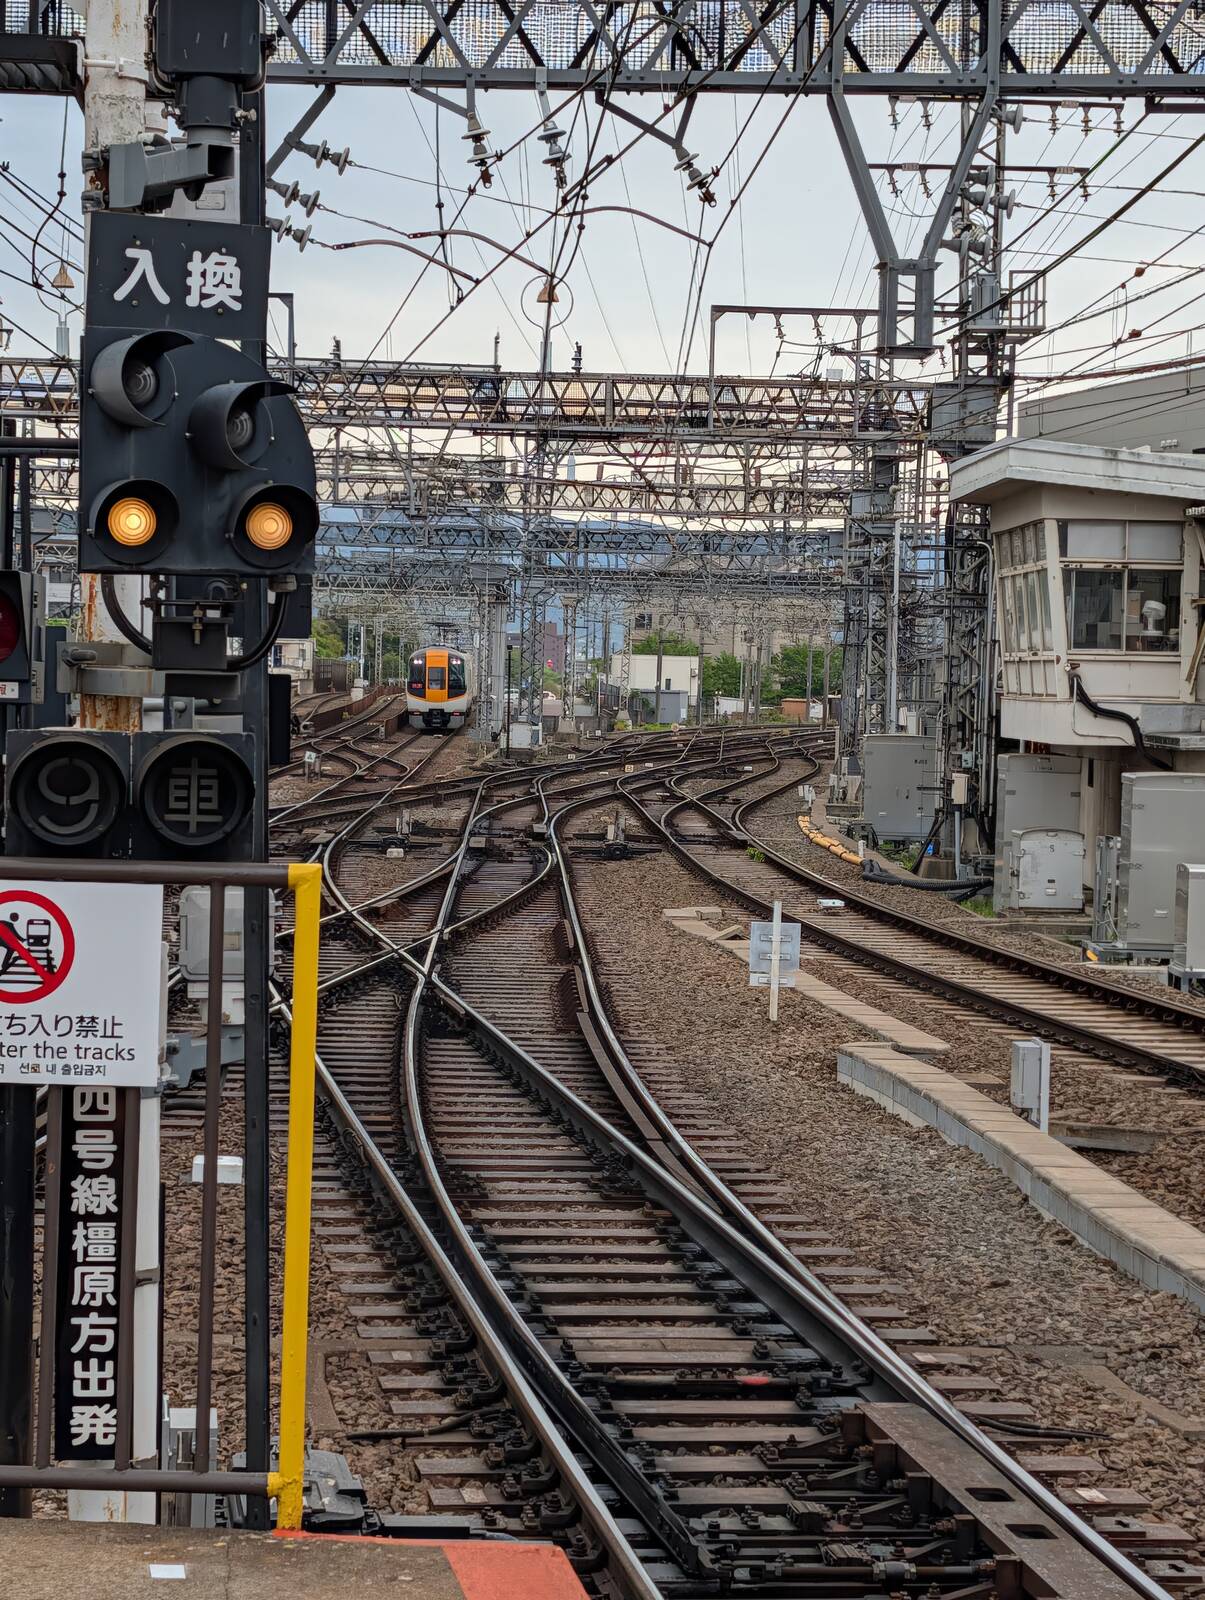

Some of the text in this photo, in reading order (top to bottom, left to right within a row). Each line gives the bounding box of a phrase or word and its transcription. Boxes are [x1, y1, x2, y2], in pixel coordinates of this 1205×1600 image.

[113, 247, 242, 311] 入換
[0, 1012, 124, 1039] ち入り禁止
[33, 1041, 67, 1059] the
[74, 1043, 136, 1061] tracks
[61, 1063, 107, 1077] 출입금지
[69, 1086, 118, 1446] 四号線橿原方出発
